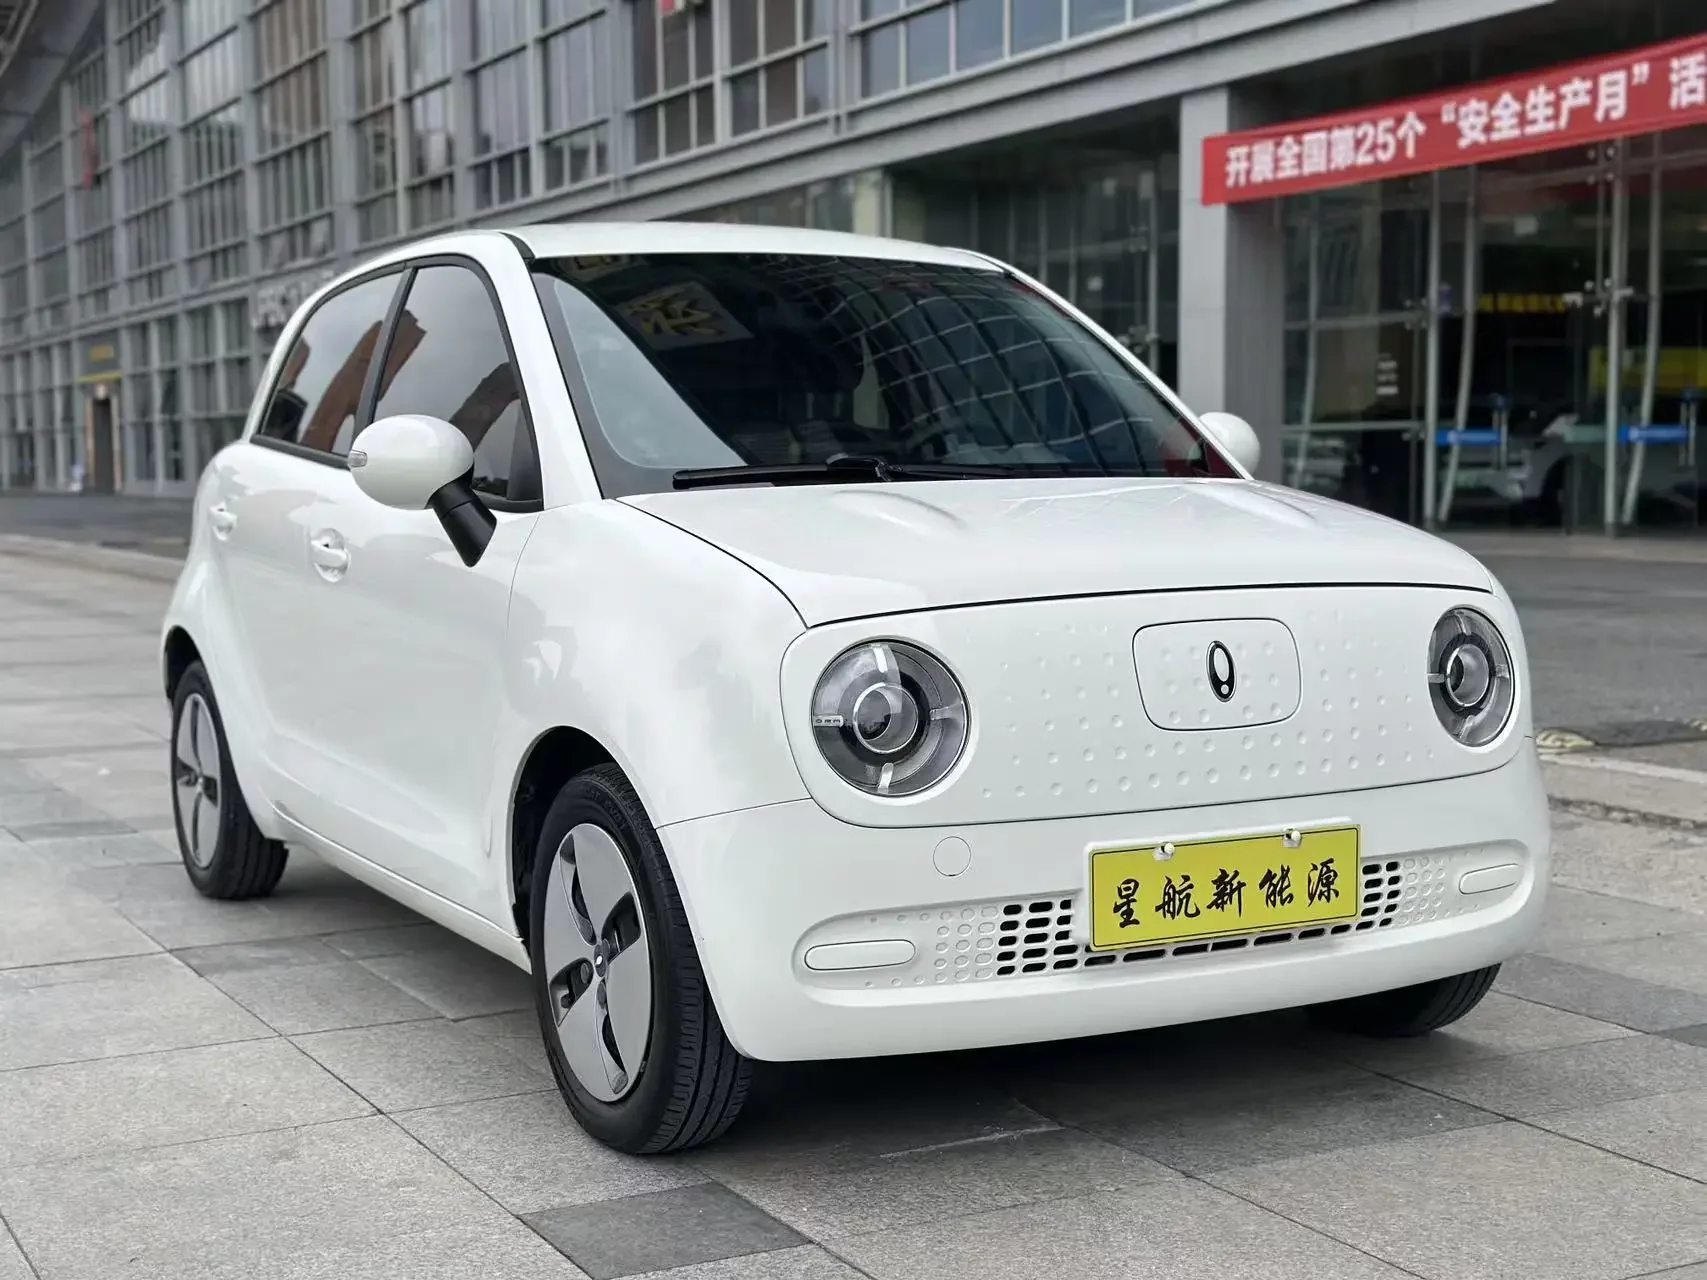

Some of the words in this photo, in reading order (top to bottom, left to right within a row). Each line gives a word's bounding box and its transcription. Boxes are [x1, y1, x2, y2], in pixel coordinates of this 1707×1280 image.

[1113, 857, 1340, 928] 星航新能源
